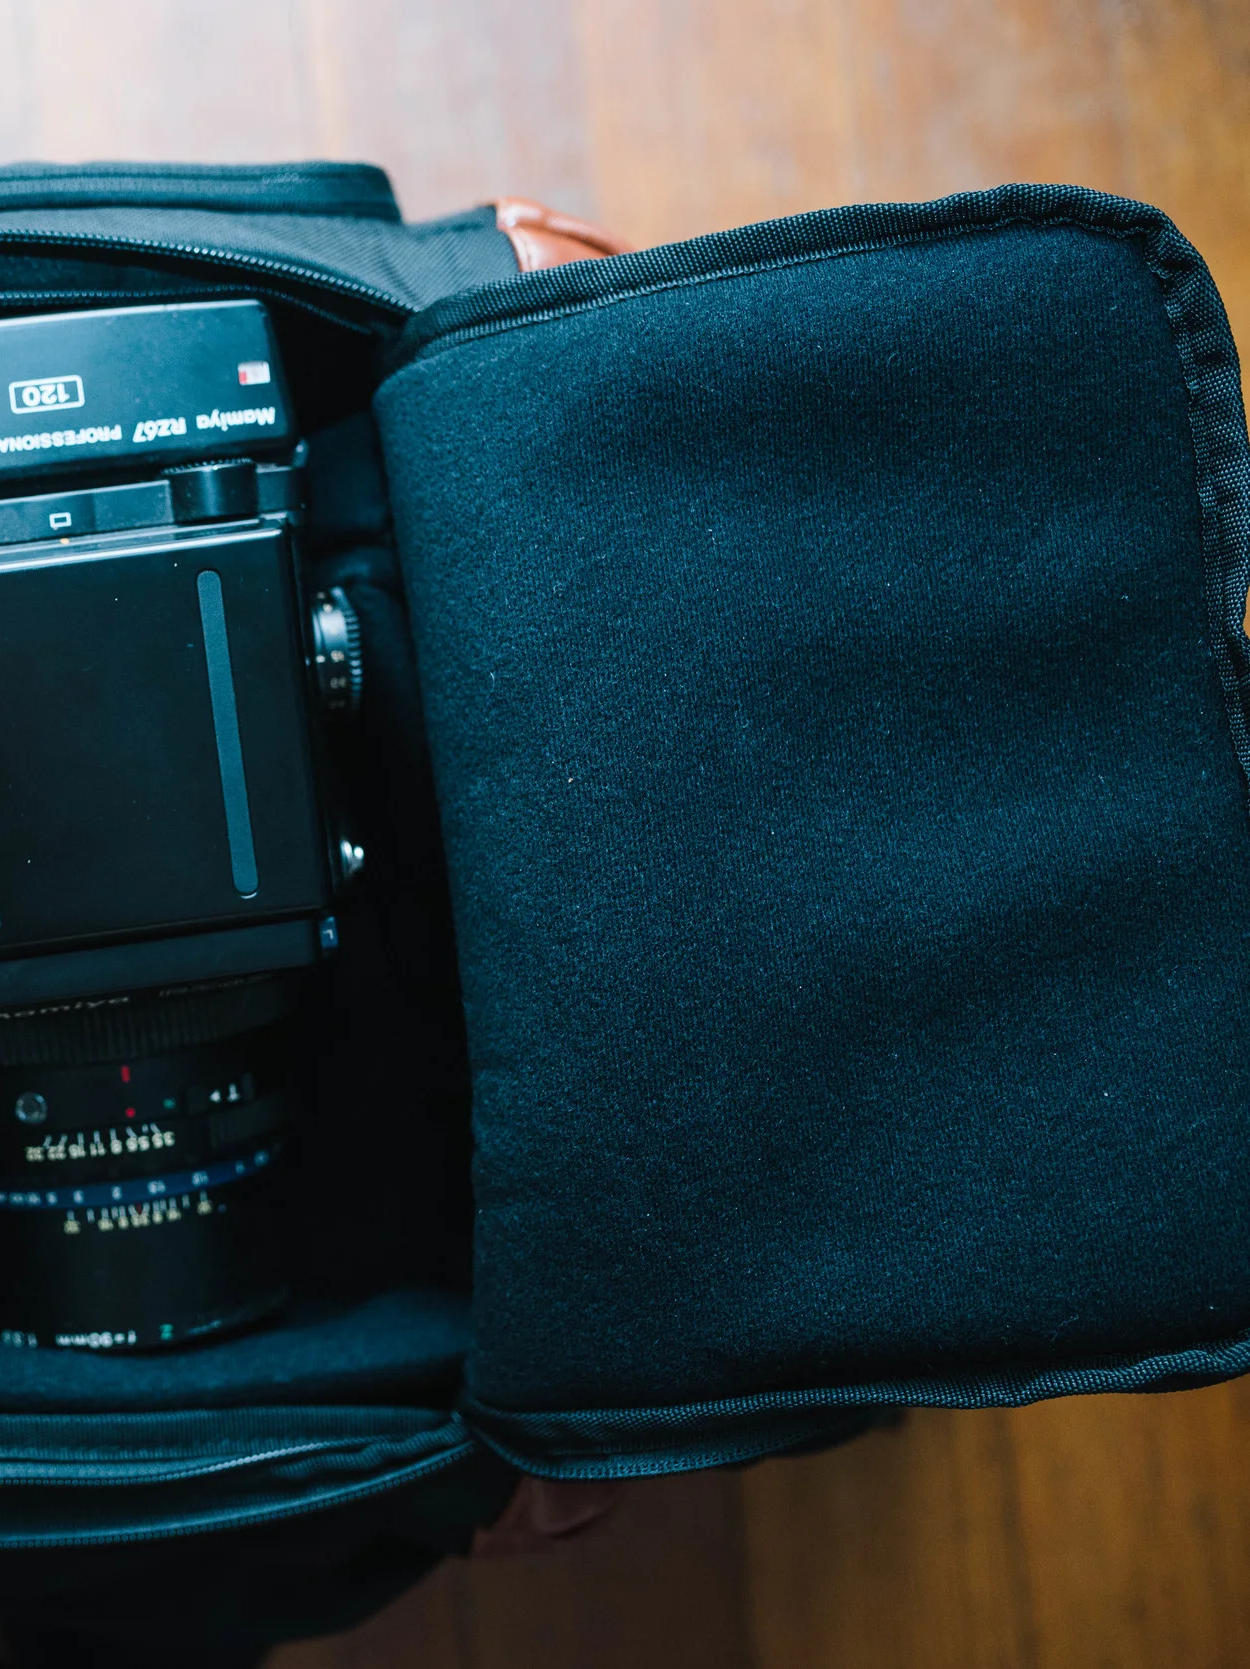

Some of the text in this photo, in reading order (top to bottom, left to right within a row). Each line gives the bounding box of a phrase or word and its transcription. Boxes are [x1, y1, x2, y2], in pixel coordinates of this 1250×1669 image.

[21, 384, 71, 407] 120
[132, 416, 188, 444] RZ67
[195, 406, 276, 433] Mamiya
